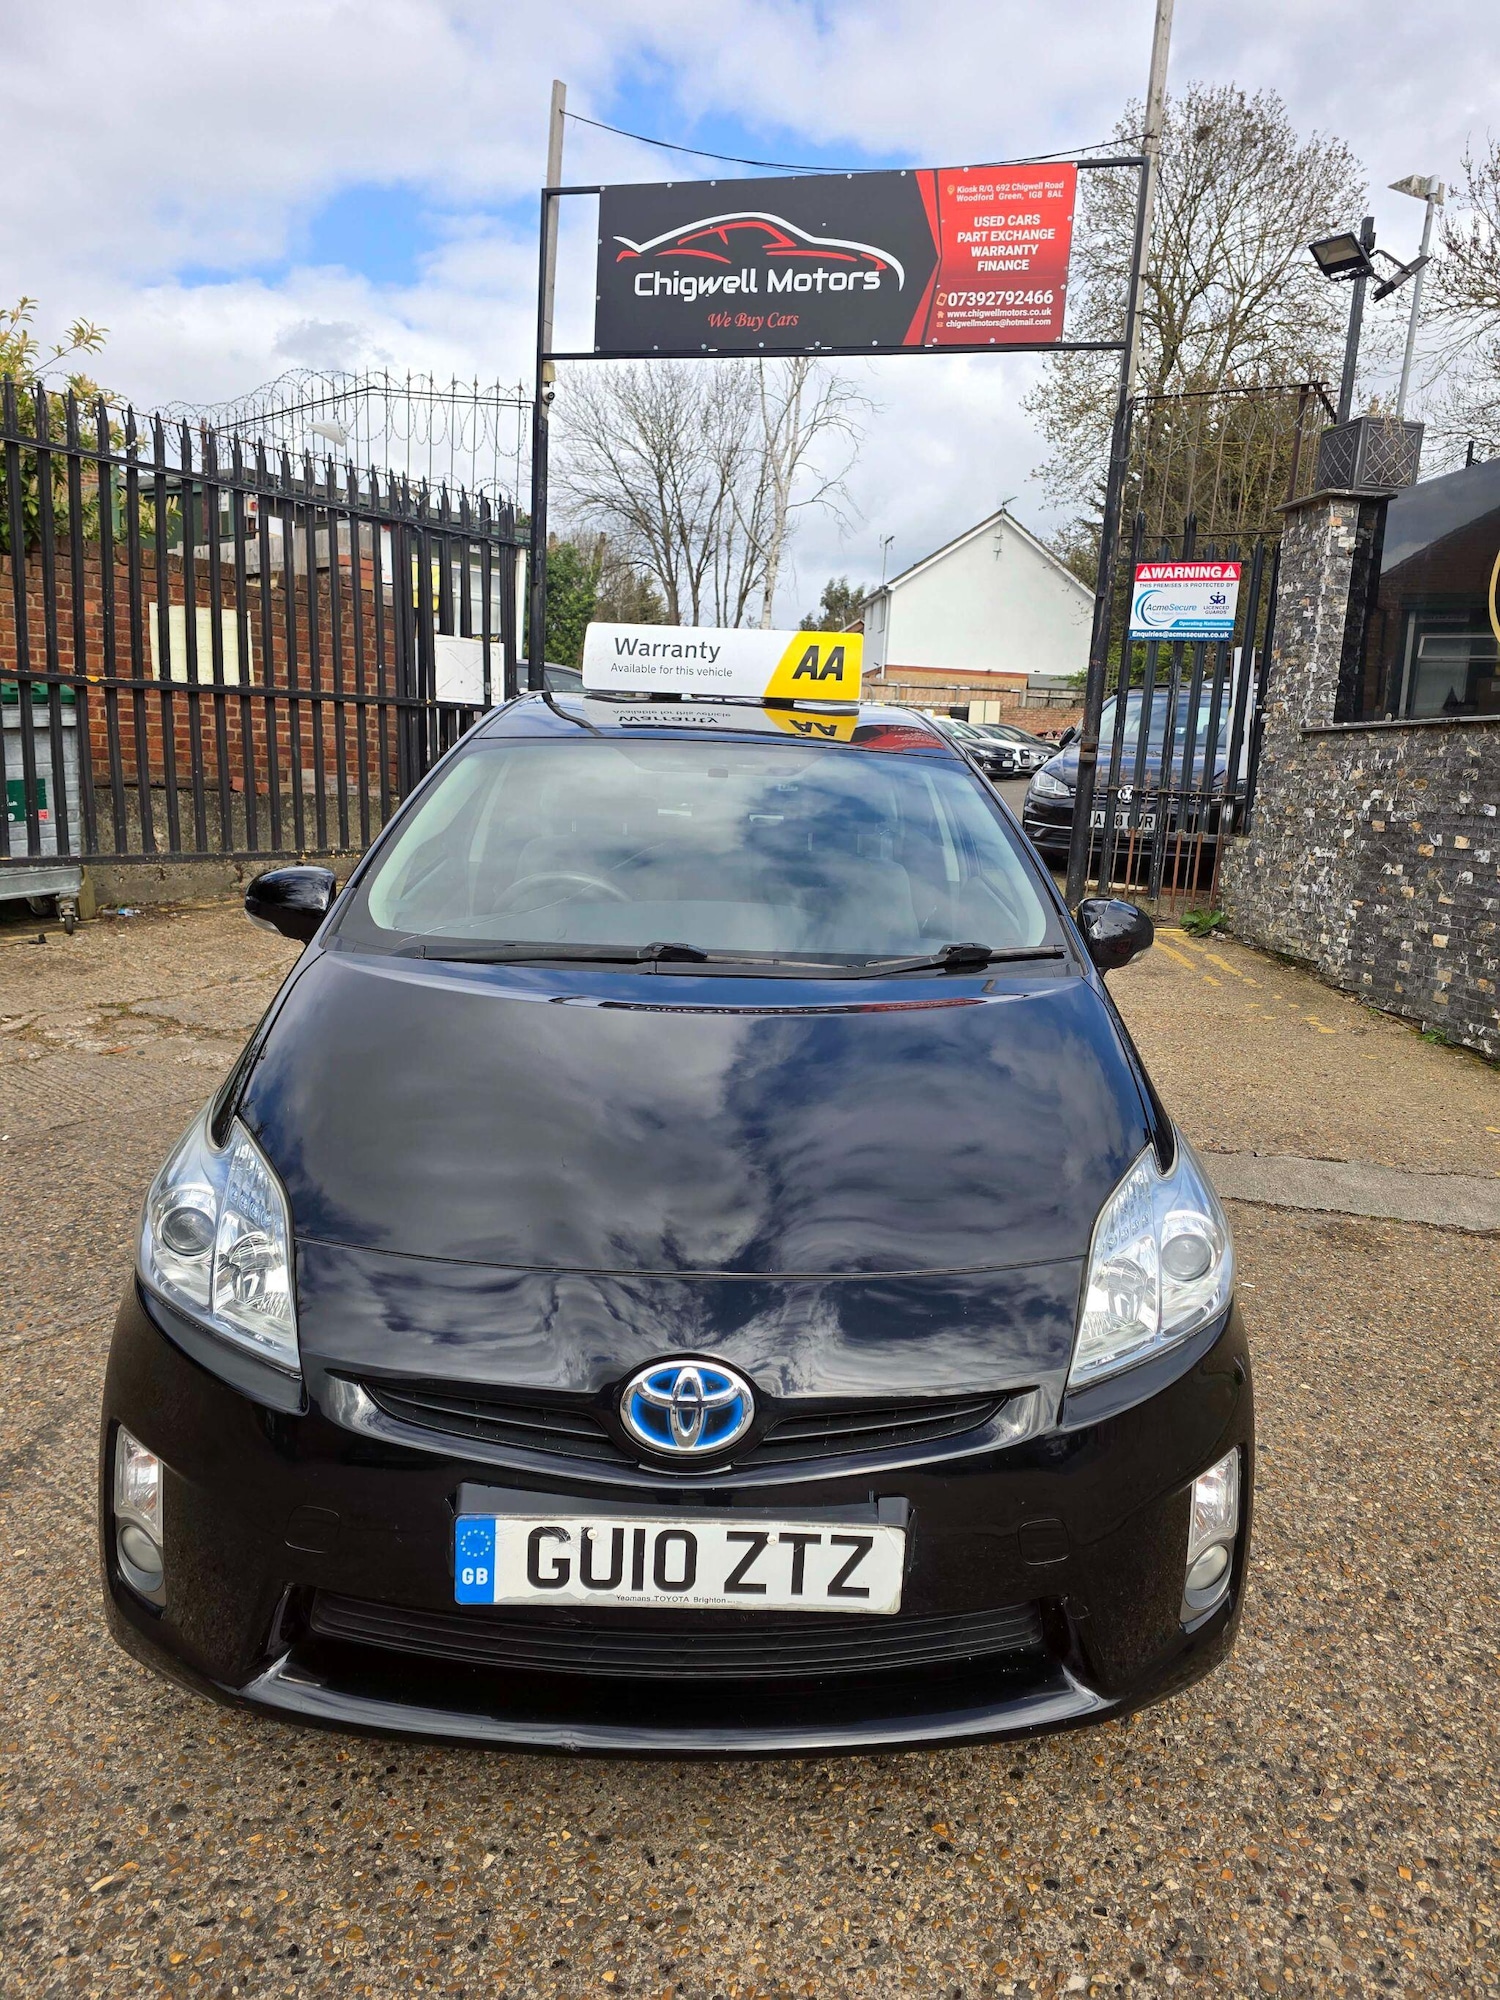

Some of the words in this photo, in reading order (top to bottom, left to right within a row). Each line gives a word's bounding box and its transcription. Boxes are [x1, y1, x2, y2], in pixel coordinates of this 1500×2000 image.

[957, 185, 978, 194] Kiosk
[996, 183, 1010, 191] 692
[1011, 182, 1043, 192] Chigwell
[1044, 181, 1064, 189] Road
[956, 193, 994, 202] Woodford
[998, 192, 1024, 200] Green,
[1029, 191, 1042, 199] IG8
[1047, 190, 1063, 198] 8AL
[974, 216, 1005, 227] USED
[1007, 214, 1040, 225] CARS
[957, 231, 988, 243] PART
[990, 228, 1055, 242] EXCHANGE
[971, 244, 1039, 257] WARRANTY
[977, 259, 1030, 272] FINANCE
[634, 267, 758, 302] Chigwell
[766, 267, 881, 293] Motors
[947, 289, 1054, 307] 07392792466
[947, 307, 1051, 318] www.chigwellmotors.co.uk
[708, 311, 731, 327] We
[734, 312, 764, 332] Buy
[767, 312, 799, 328] Cars
[946, 319, 1051, 329] chigwellmotors@hotmail.com
[1151, 566, 1222, 578] WARNING
[1146, 604, 1197, 612] AcmeSecure
[1132, 631, 1229, 639] Enquiries@acmesecure.co.uk
[614, 637, 721, 663] Warranty
[792, 645, 845, 681] AA
[611, 663, 656, 674] Available
[659, 665, 673, 675] for
[676, 665, 694, 676] this
[697, 667, 733, 678] vehicle
[526, 1525, 698, 1592] GU10
[723, 1530, 874, 1599] ZTZ
[461, 1567, 489, 1585] GB
[654, 1595, 689, 1603] TOYOTA
[693, 1596, 726, 1604] Brighton
